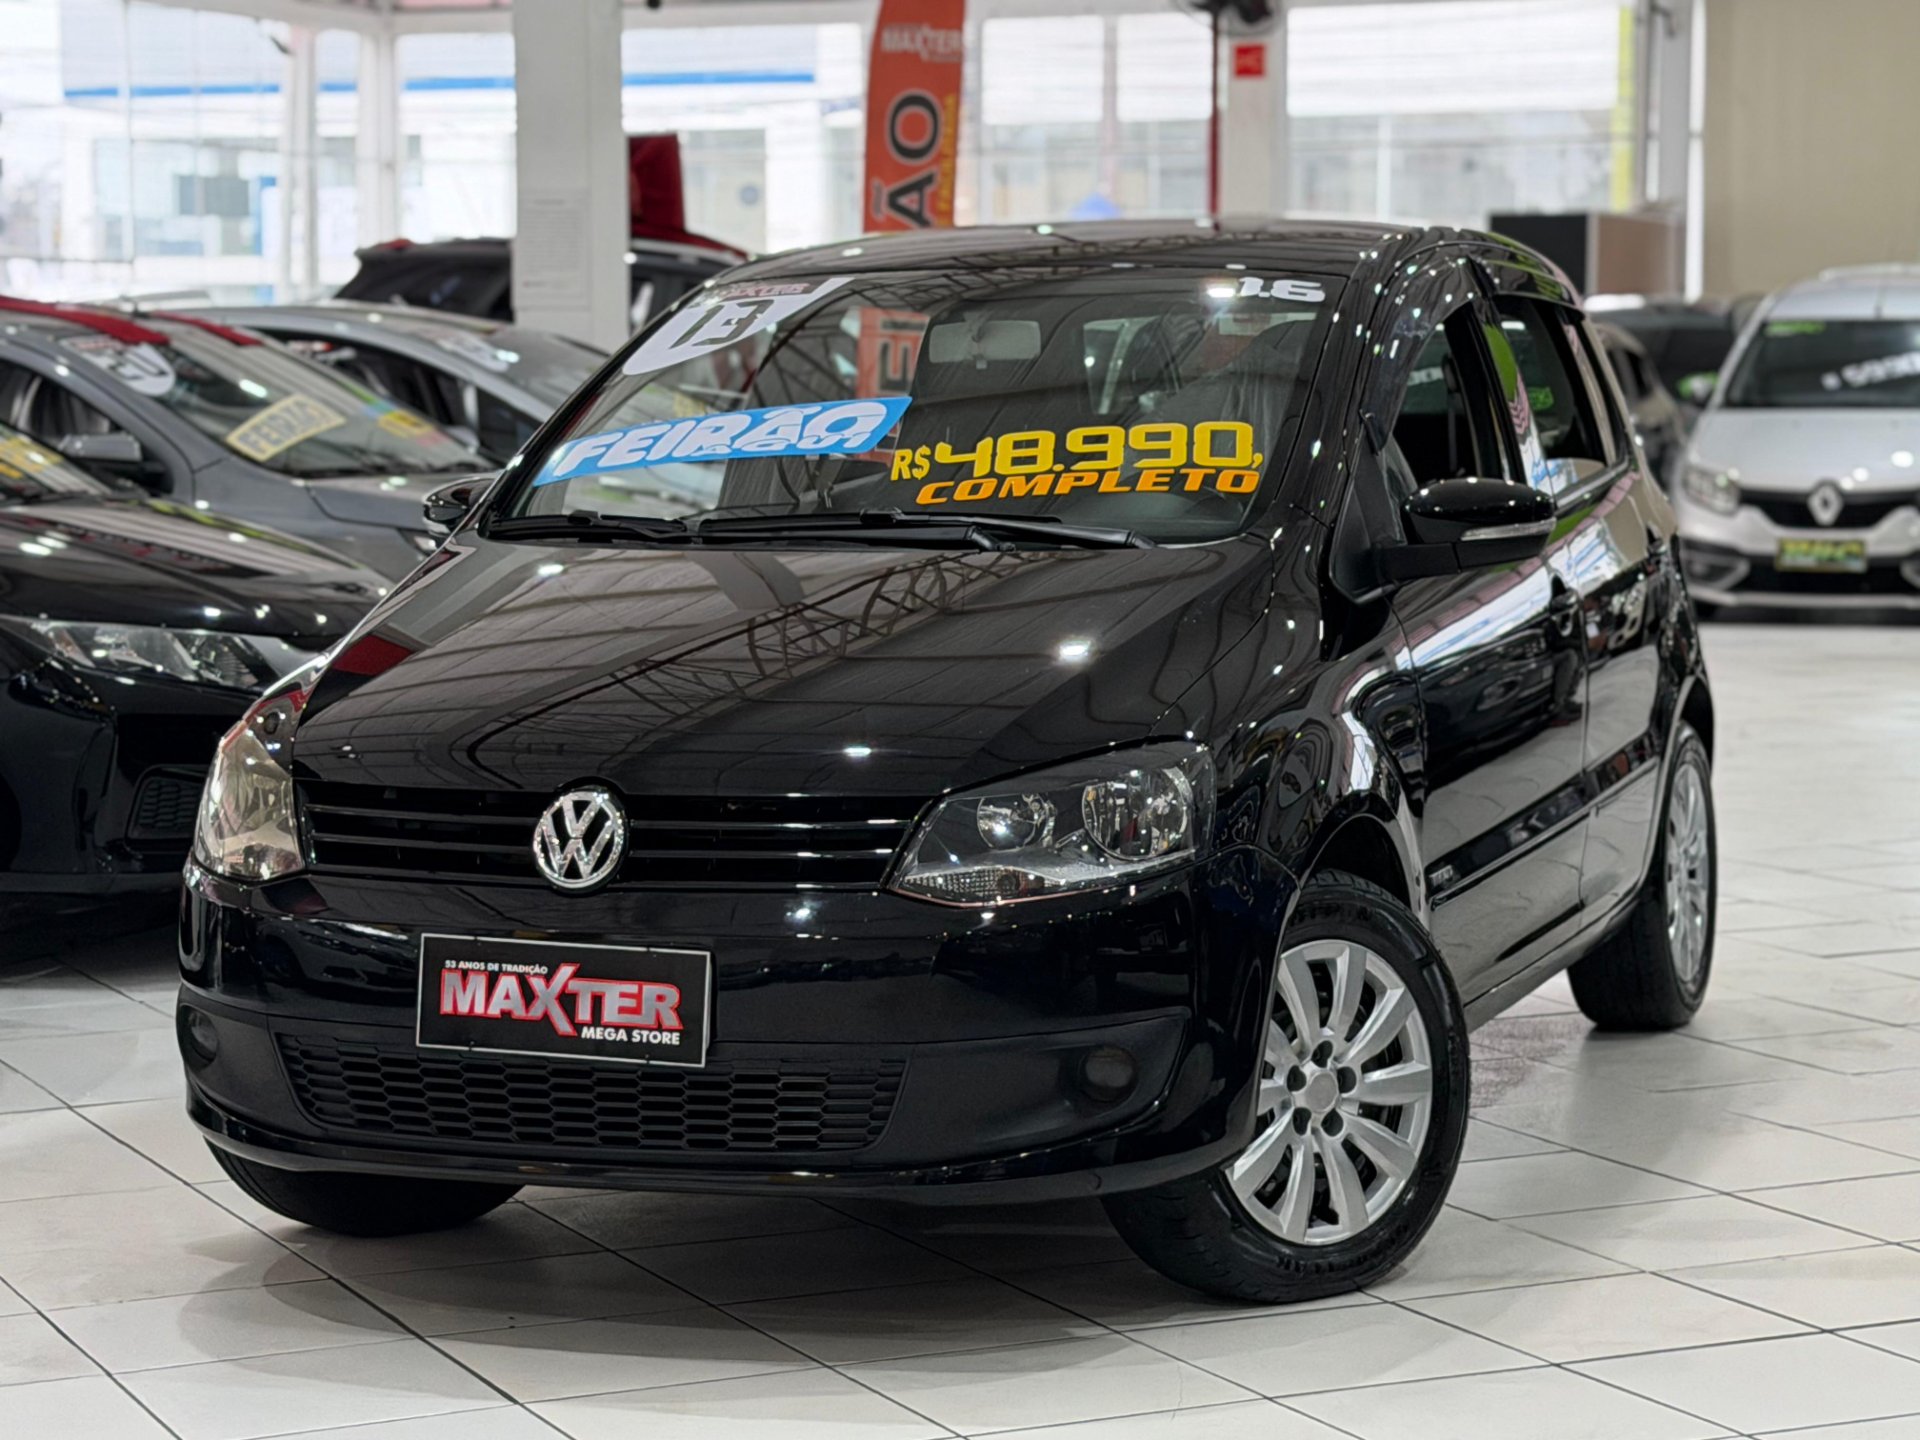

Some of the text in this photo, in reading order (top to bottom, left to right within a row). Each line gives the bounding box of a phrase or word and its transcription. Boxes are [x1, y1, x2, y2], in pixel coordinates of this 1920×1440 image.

[1238, 276, 1326, 302] 1.6
[553, 402, 887, 476] FEIRÃO
[915, 468, 1260, 505] COMPLETO
[458, 961, 485, 970] ANOS
[487, 963, 500, 972] DE
[501, 964, 548, 976] TRADIÇÃO
[440, 963, 683, 1036] MAXTER
[581, 1026, 681, 1045] MEGA STORE
